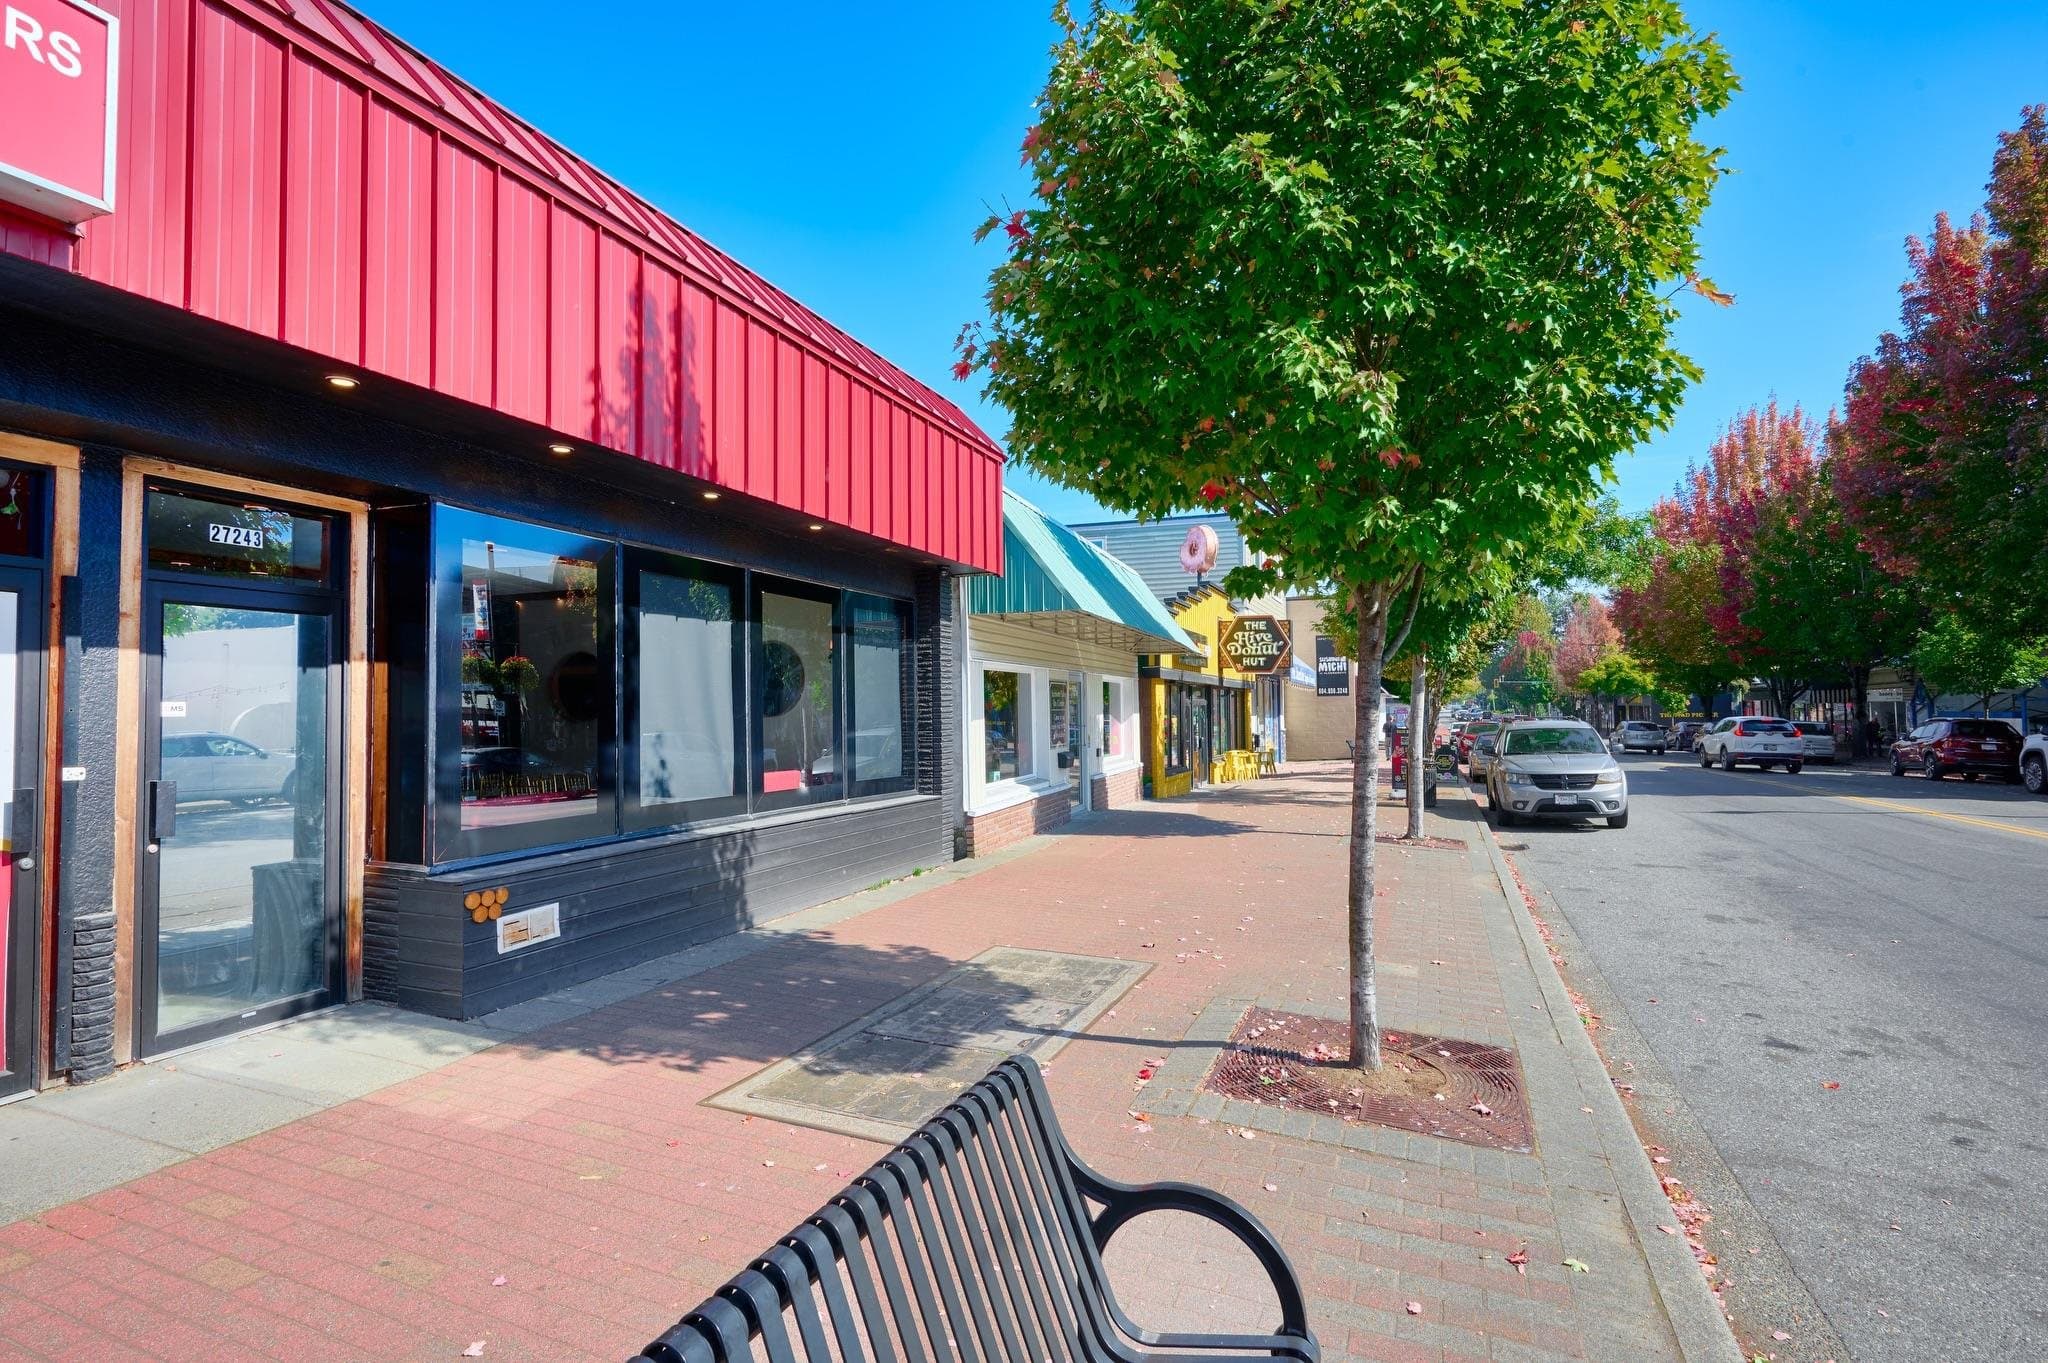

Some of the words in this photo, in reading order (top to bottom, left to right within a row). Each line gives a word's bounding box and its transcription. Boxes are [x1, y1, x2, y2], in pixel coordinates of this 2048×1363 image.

[5, 4, 82, 78] RS
[211, 525, 261, 547] 27243
[1243, 620, 1267, 631] THE
[1233, 631, 1273, 648] Hive
[1226, 640, 1285, 656] Donut
[1242, 656, 1267, 667] HUT
[1318, 661, 1347, 672] MICHI
